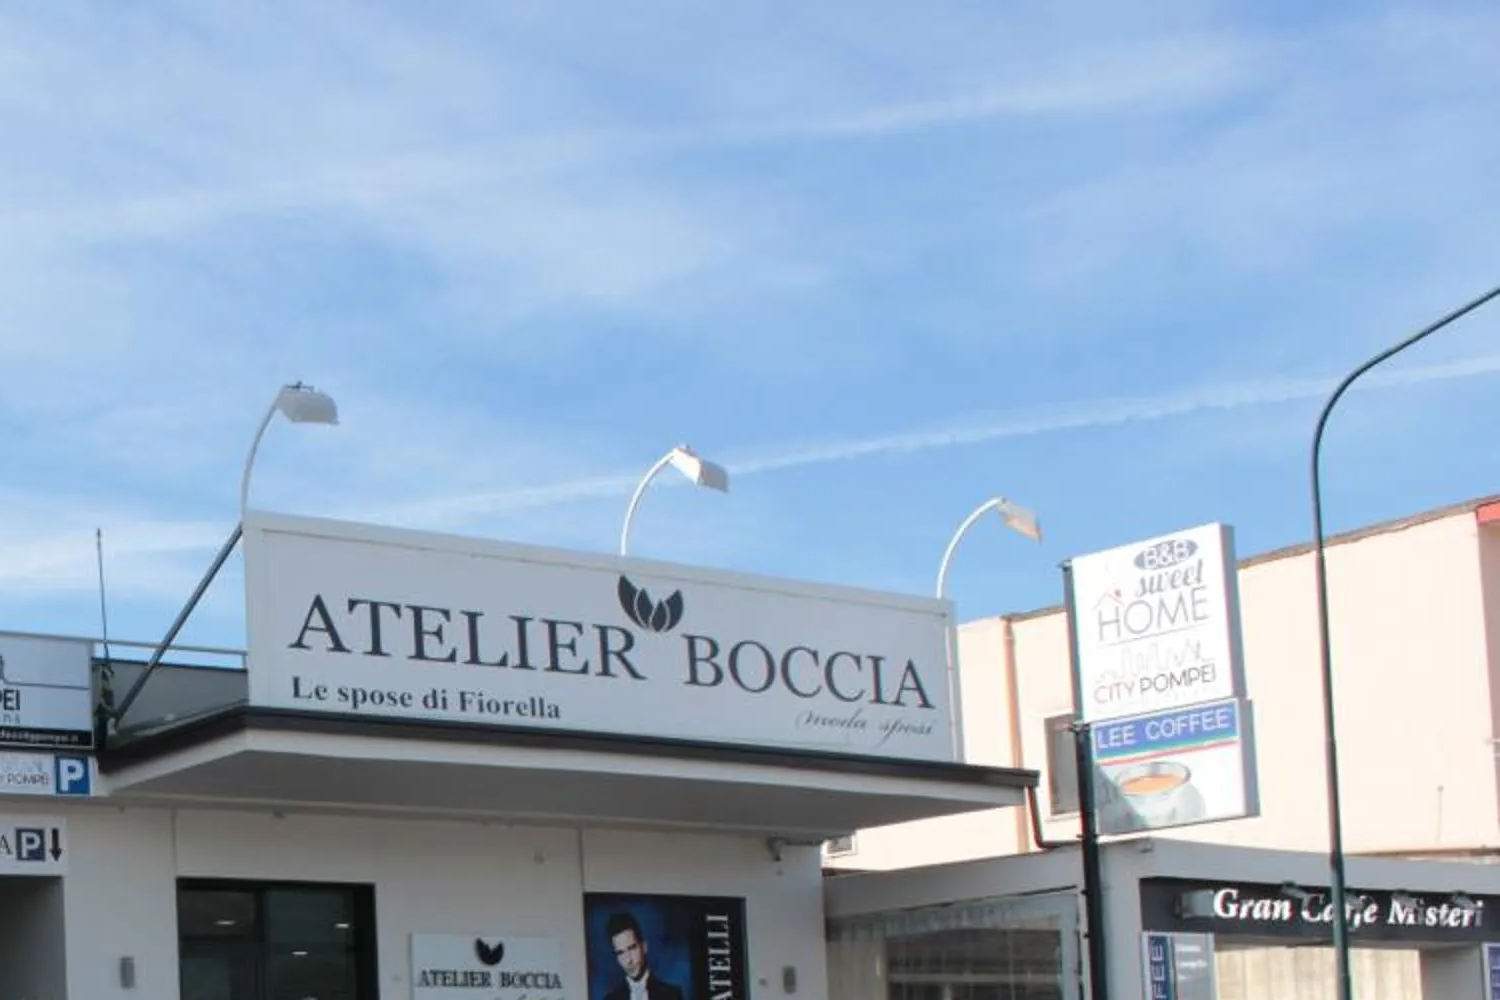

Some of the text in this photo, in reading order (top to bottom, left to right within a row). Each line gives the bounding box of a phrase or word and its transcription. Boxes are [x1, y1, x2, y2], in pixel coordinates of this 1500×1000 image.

[1143, 539, 1190, 569] B&B
[1135, 558, 1205, 597] sweet
[1097, 585, 1210, 641] HOME
[287, 594, 936, 710] ATELIER BOCCIA
[291, 676, 562, 719] Le spose di Fiorella
[1093, 680, 1136, 704] CITY
[1139, 663, 1217, 694] POMPEI
[1096, 707, 1231, 749] LEE COFFEE
[58, 758, 85, 792] P
[20, 831, 41, 859] P
[1213, 888, 1292, 921] Gran
[418, 969, 563, 989] ATELIER BOCCIA
